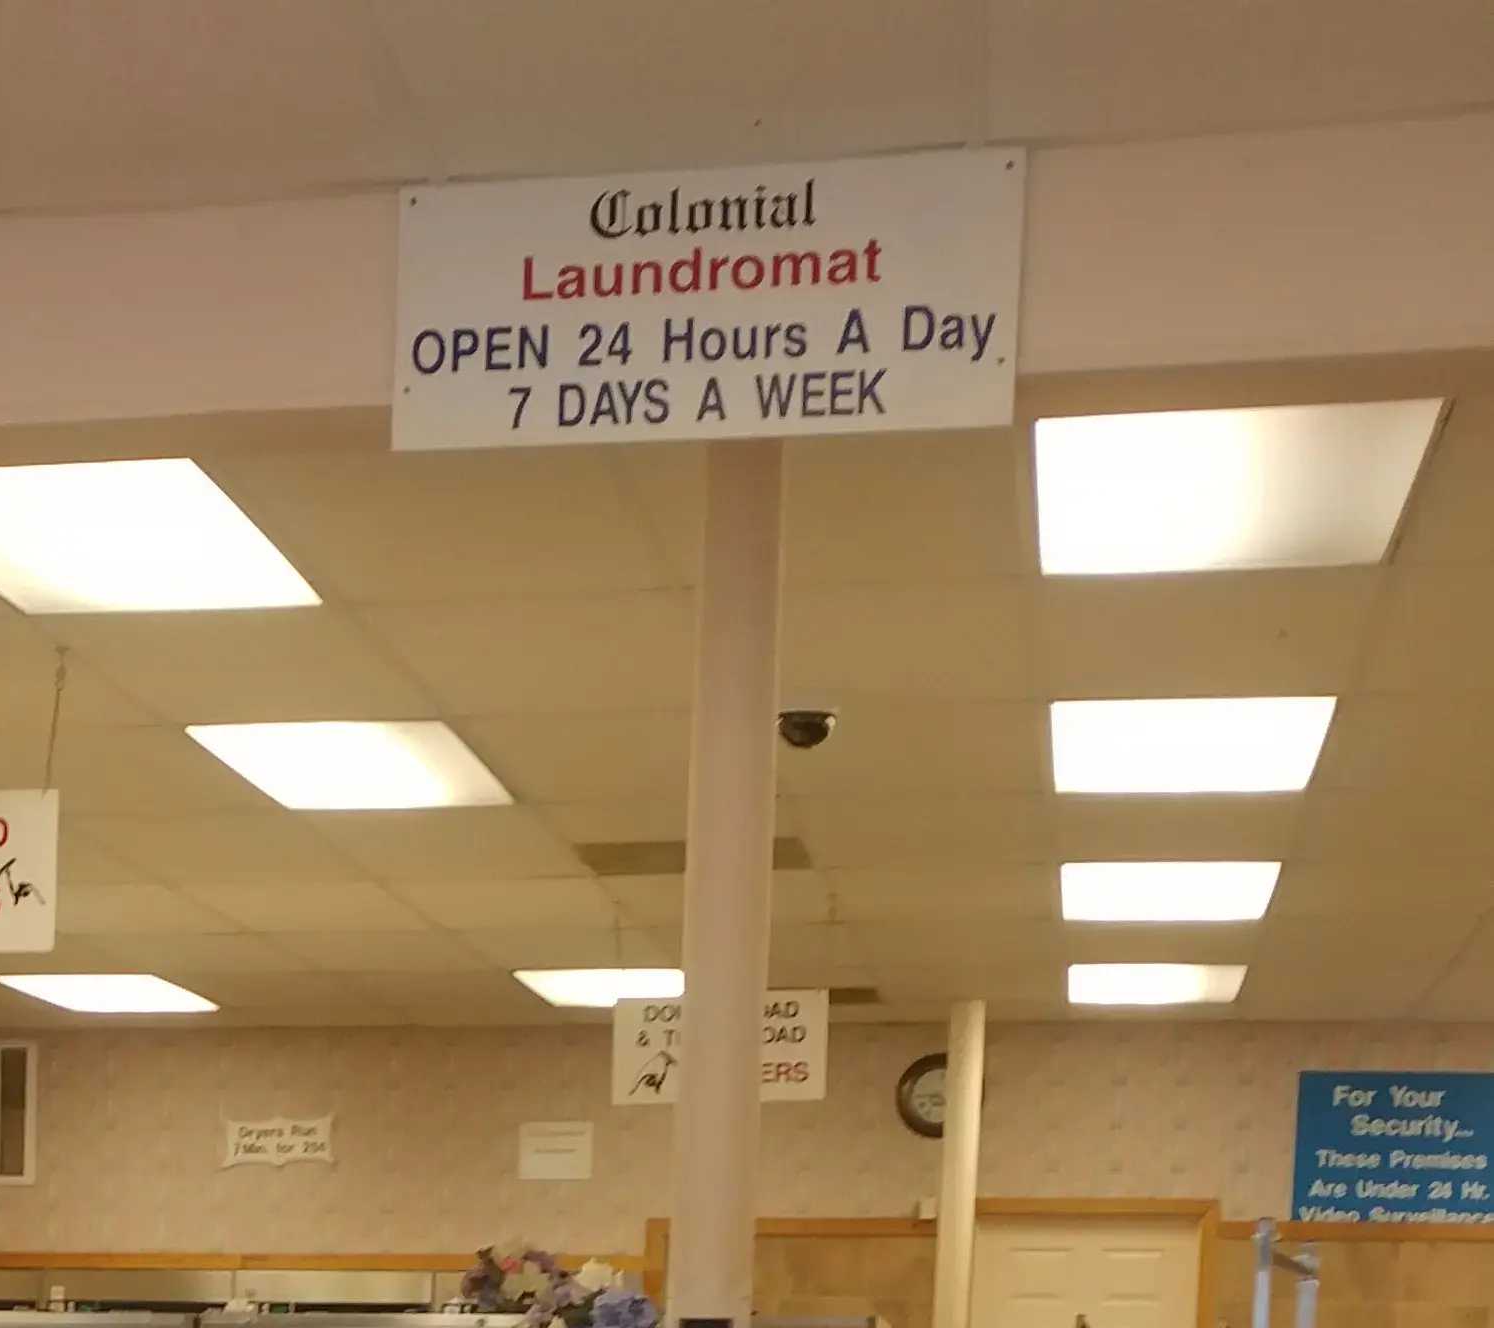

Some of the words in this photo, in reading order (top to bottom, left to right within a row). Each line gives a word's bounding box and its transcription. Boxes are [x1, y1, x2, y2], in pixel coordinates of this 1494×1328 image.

[589, 179, 817, 239] Colonial
[522, 238, 883, 300] Laundromat
[411, 325, 550, 374] OPEN
[578, 323, 632, 366] 24
[663, 317, 808, 362] Hours
[837, 308, 871, 355] A
[903, 305, 996, 361] Day
[508, 386, 531, 429] 7
[557, 379, 669, 427] DAYS
[697, 377, 726, 422] A
[756, 368, 887, 419] WEEK
[643, 1005, 682, 1023] DO
[764, 1001, 800, 1019] AD
[636, 1030, 650, 1047] &
[1333, 1085, 1378, 1107] For
[1389, 1084, 1447, 1108] Your
[1316, 1149, 1382, 1169] These
[1389, 1150, 1489, 1170] Premises
[1309, 1179, 1349, 1198] Are
[1356, 1180, 1419, 1199] Under
[1427, 1181, 1453, 1199] 24
